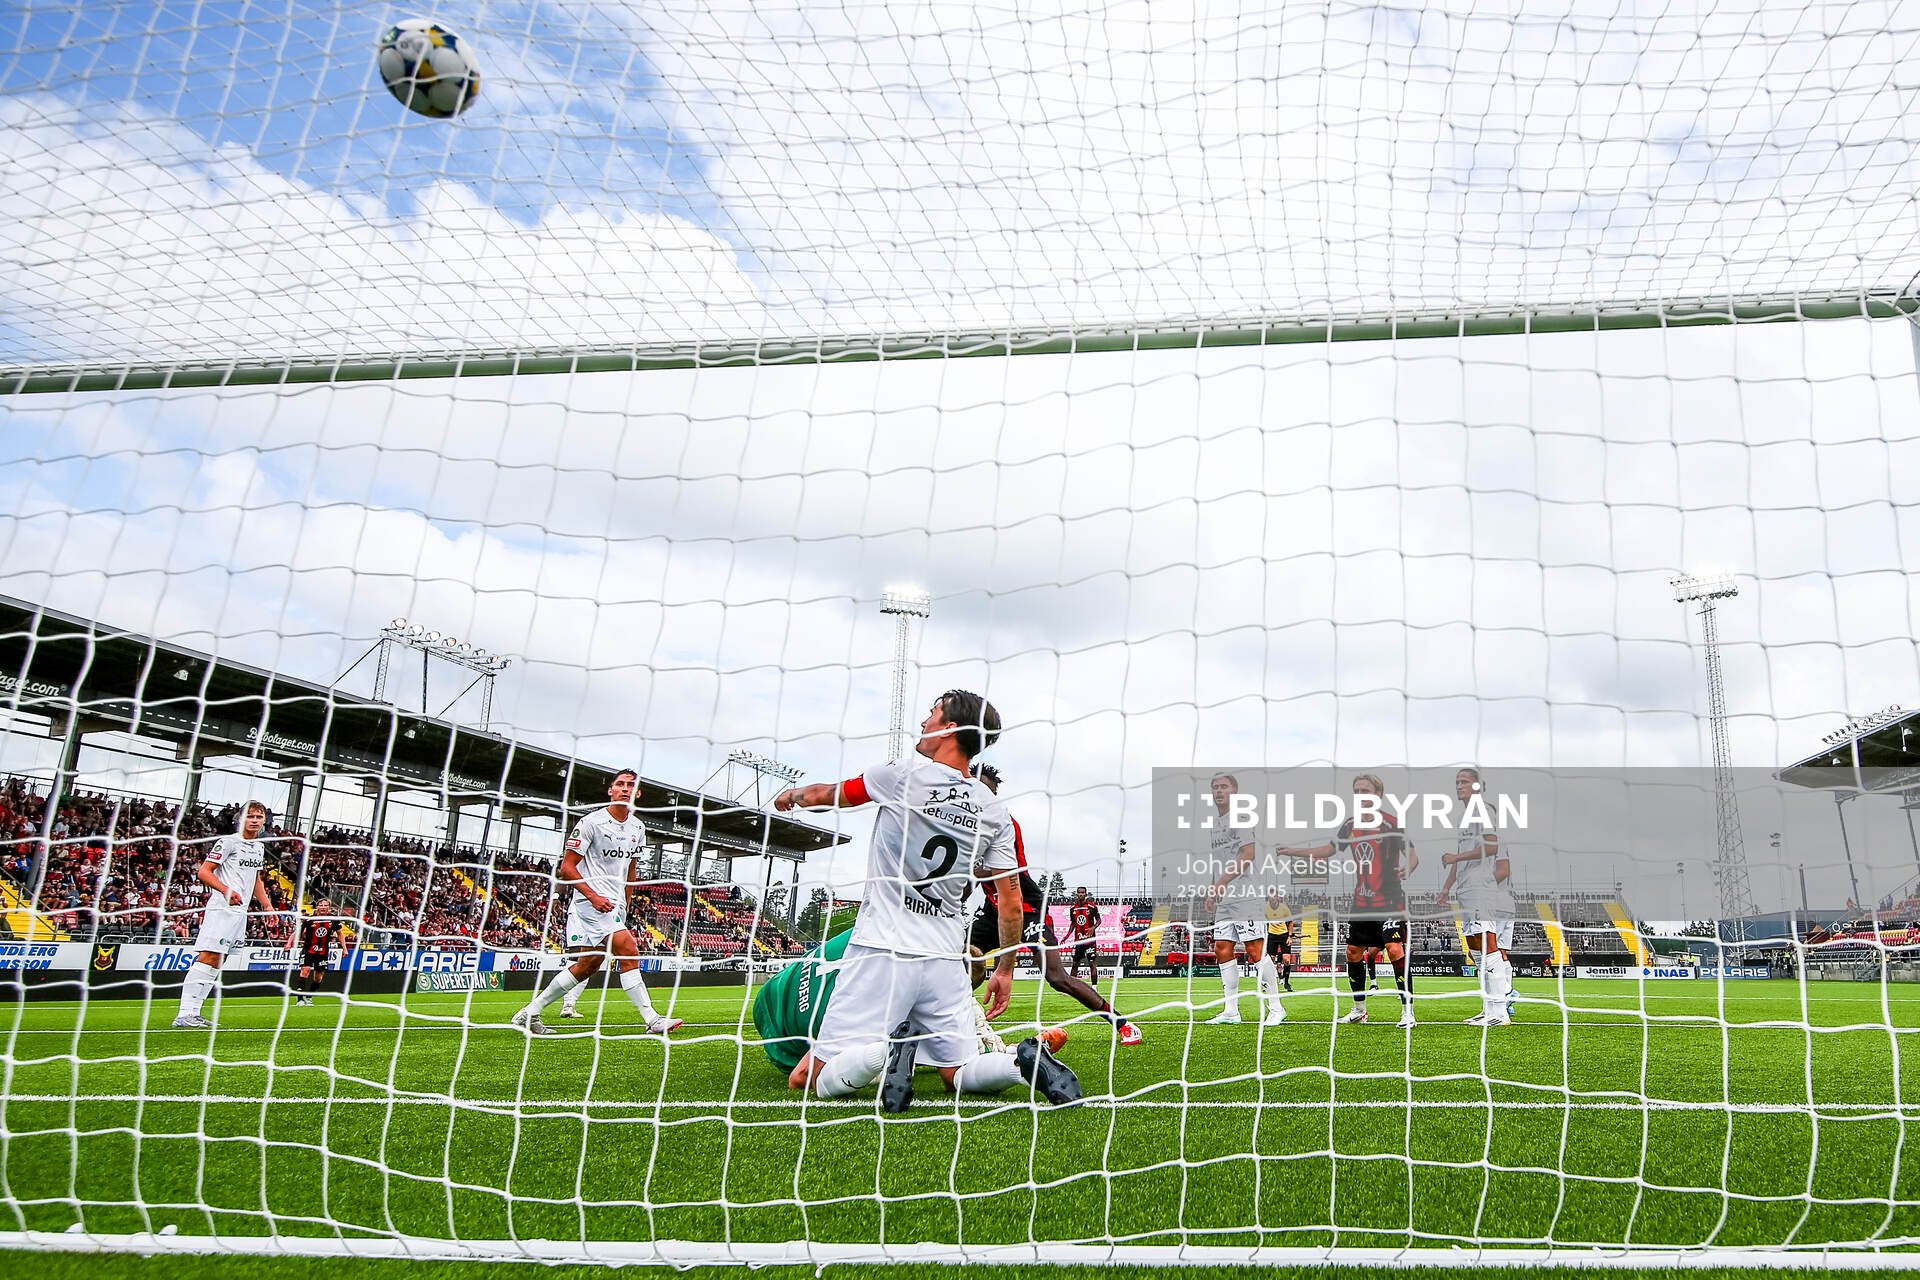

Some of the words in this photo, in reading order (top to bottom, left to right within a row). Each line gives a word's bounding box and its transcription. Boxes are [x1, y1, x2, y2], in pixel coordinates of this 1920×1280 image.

[921, 835, 959, 909] 2
[360, 951, 479, 972] POLARIS
[1654, 968, 1689, 977] INAB
[1700, 968, 1769, 977] POLARIS
